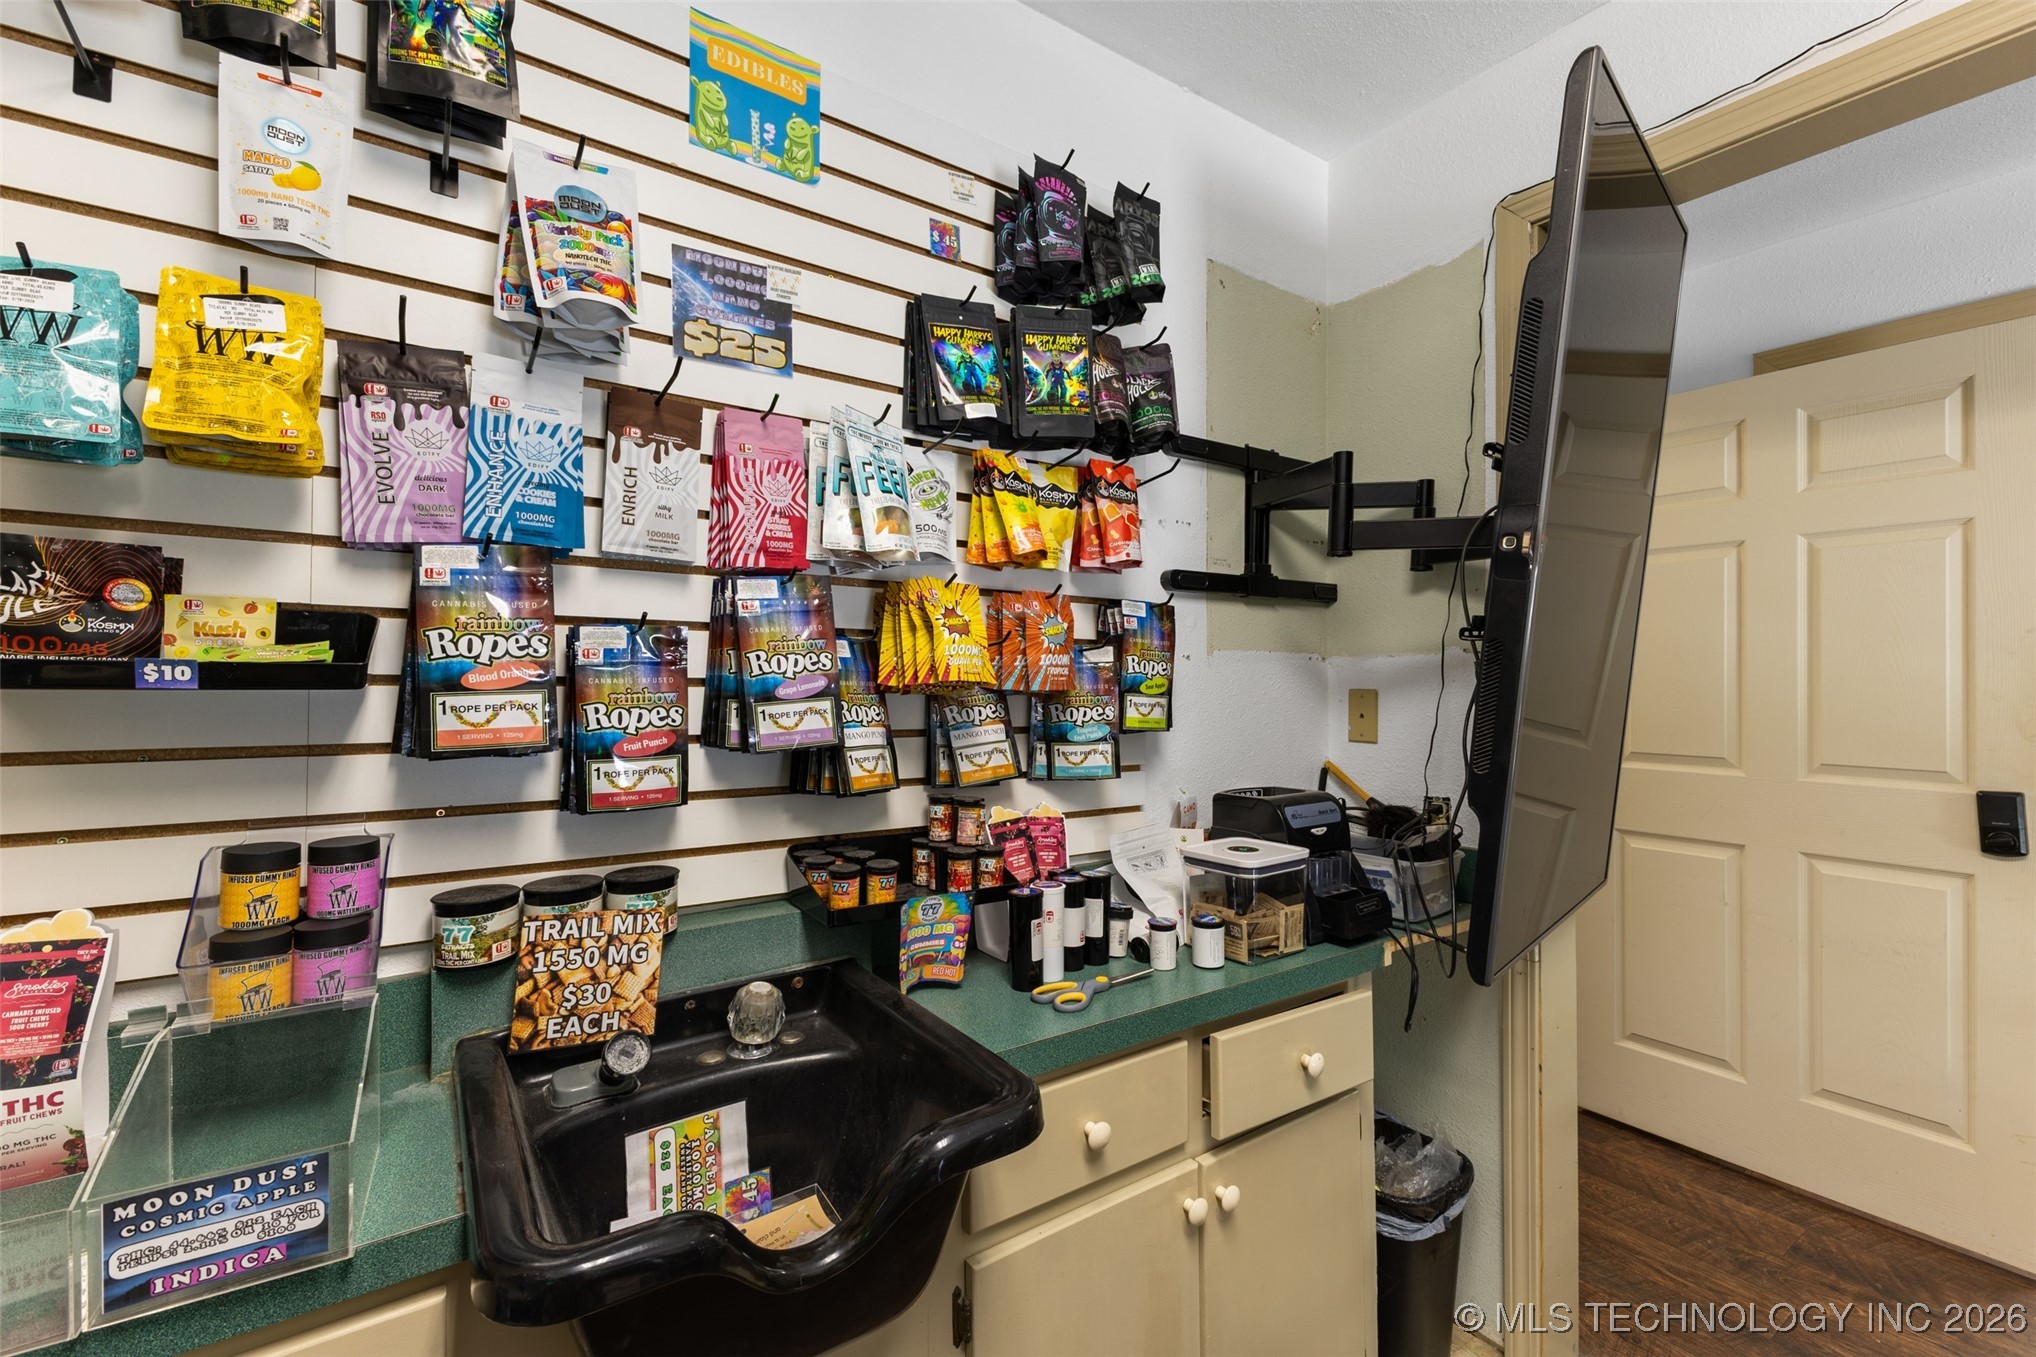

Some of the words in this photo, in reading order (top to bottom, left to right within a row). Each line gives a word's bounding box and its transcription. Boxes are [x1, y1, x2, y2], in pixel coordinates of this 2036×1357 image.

[712, 44, 804, 97] EDIBLES
[266, 131, 304, 148] DUST
[267, 124, 306, 143] MOON
[242, 149, 292, 170] MANGO
[242, 164, 275, 177] SATIVA
[237, 187, 269, 199] 1000mg
[271, 191, 295, 204] NANO
[296, 197, 316, 210] TECH
[317, 206, 331, 218] THC
[542, 222, 593, 241] Variety
[595, 230, 625, 248] Pack
[932, 230, 940, 243] $
[943, 235, 958, 248] 45
[558, 238, 616, 260] 2000mg
[711, 291, 760, 311] NANO
[695, 304, 776, 331] GUMMIES
[684, 317, 787, 369] $25
[370, 411, 386, 420] RSO
[373, 432, 396, 505] EVOLVE
[485, 429, 507, 519] ENHANCE
[527, 462, 550, 470] EDIFY
[414, 475, 448, 483] delicious
[908, 469, 937, 488] SUPER
[418, 483, 447, 493] DARK
[517, 488, 557, 500] COOKIES
[621, 466, 638, 526] ENRICH
[1039, 484, 1076, 506] KOSMIK
[411, 503, 456, 513] 1000MG
[654, 511, 674, 521] MILK
[515, 511, 556, 524] 1000MG
[646, 529, 681, 541] 1000MG
[765, 540, 794, 549] 1000MG
[87, 616, 134, 635] KOSMIK
[193, 619, 248, 639] Kush
[456, 612, 544, 633] rainbow
[749, 626, 788, 634] CANNABIS
[424, 627, 551, 666] Ropes
[767, 635, 828, 652] rainbow
[1140, 646, 1171, 660] rainbow
[143, 662, 192, 683] $10
[745, 650, 834, 681] Ropes
[1047, 667, 1069, 676] TROPICAL
[1126, 654, 1172, 680] Ropes
[468, 671, 499, 684] Blood
[500, 668, 535, 680] Orange
[588, 676, 634, 685] CANNABIS
[637, 676, 674, 684] INFUSED
[779, 686, 797, 696] Grape
[798, 679, 826, 692] Lemonade
[608, 688, 679, 706] rainbow
[1064, 691, 1116, 705] rainbow
[438, 700, 447, 716] 1
[450, 704, 481, 714] ROPE
[484, 703, 507, 712] PER
[509, 701, 539, 712] PACK
[759, 710, 767, 722] 1
[768, 711, 791, 720] ROPE
[809, 708, 829, 717] PACK
[943, 701, 1006, 727] Ropes
[1049, 704, 1115, 727] Ropes
[582, 702, 685, 735] Ropes
[953, 730, 980, 741] MANGO
[981, 726, 1005, 736] PUNCH
[623, 741, 644, 752] Fruit
[644, 737, 669, 748] Punch
[593, 766, 601, 781] 1
[603, 769, 629, 779] ROPE
[632, 768, 650, 777] PER
[652, 767, 675, 776] PACK
[228, 875, 254, 884] INFUSED
[255, 873, 282, 883] GUMMY
[282, 870, 297, 881] RINGS
[312, 866, 334, 875] INFUSED
[335, 863, 360, 873] GUMMY
[360, 861, 376, 870] RINGS
[812, 872, 828, 882] 77
[832, 882, 850, 893] 77
[879, 877, 895, 888] 77
[327, 890, 358, 909] WW
[244, 902, 278, 921] WW
[338, 904, 371, 916] WATERMELON
[921, 903, 943, 916] 77
[232, 920, 265, 929] 1000MG
[267, 916, 291, 926] PEACH
[524, 916, 605, 943] TRAIL
[613, 911, 661, 936] MIX
[933, 923, 955, 935] MG
[441, 924, 477, 945] 77
[910, 940, 945, 950] GUMMIES
[248, 962, 275, 973] GUMMY
[275, 955, 290, 967] RINGS
[299, 952, 323, 961] INFUSED
[324, 949, 348, 959] GUMMY
[441, 951, 460, 960] TRAIL
[460, 950, 476, 960] MIX
[533, 947, 601, 973] 1550
[607, 942, 649, 966] MG
[944, 967, 957, 976] HOT
[4, 980, 69, 999] Smokiez
[562, 982, 612, 1010] $30
[2, 1008, 34, 1018] CANNABIS
[26, 1021, 50, 1029] CHERRY
[546, 1011, 620, 1040] EACH
[2, 1091, 65, 1117] THC
[0, 1115, 27, 1127] FRUIT
[29, 1107, 63, 1120] CHEWS
[13, 1139, 31, 1148] MG
[34, 1133, 57, 1144] THC
[17, 1142, 48, 1153] SERVING
[660, 1140, 672, 1172] $25
[679, 1143, 687, 1172] SWEET
[685, 1141, 693, 1186] VARIETY
[703, 1114, 718, 1196] JACKED
[691, 1139, 704, 1211] 1000MG
[112, 1184, 214, 1223] MOON
[232, 1160, 319, 1193] DUST
[742, 1178, 759, 1202] 45
[120, 1202, 224, 1239] COSMIC
[237, 1180, 318, 1211] APPLE
[117, 1245, 163, 1263] THC:
[235, 1215, 265, 1229] $12
[271, 1202, 318, 1220] EACH
[117, 1249, 178, 1272] TERPS:
[231, 1224, 255, 1239] OR
[261, 1218, 282, 1232] 10
[287, 1208, 321, 1225] FOR
[257, 1223, 296, 1240] $100
[151, 1245, 287, 1296] INDICA
